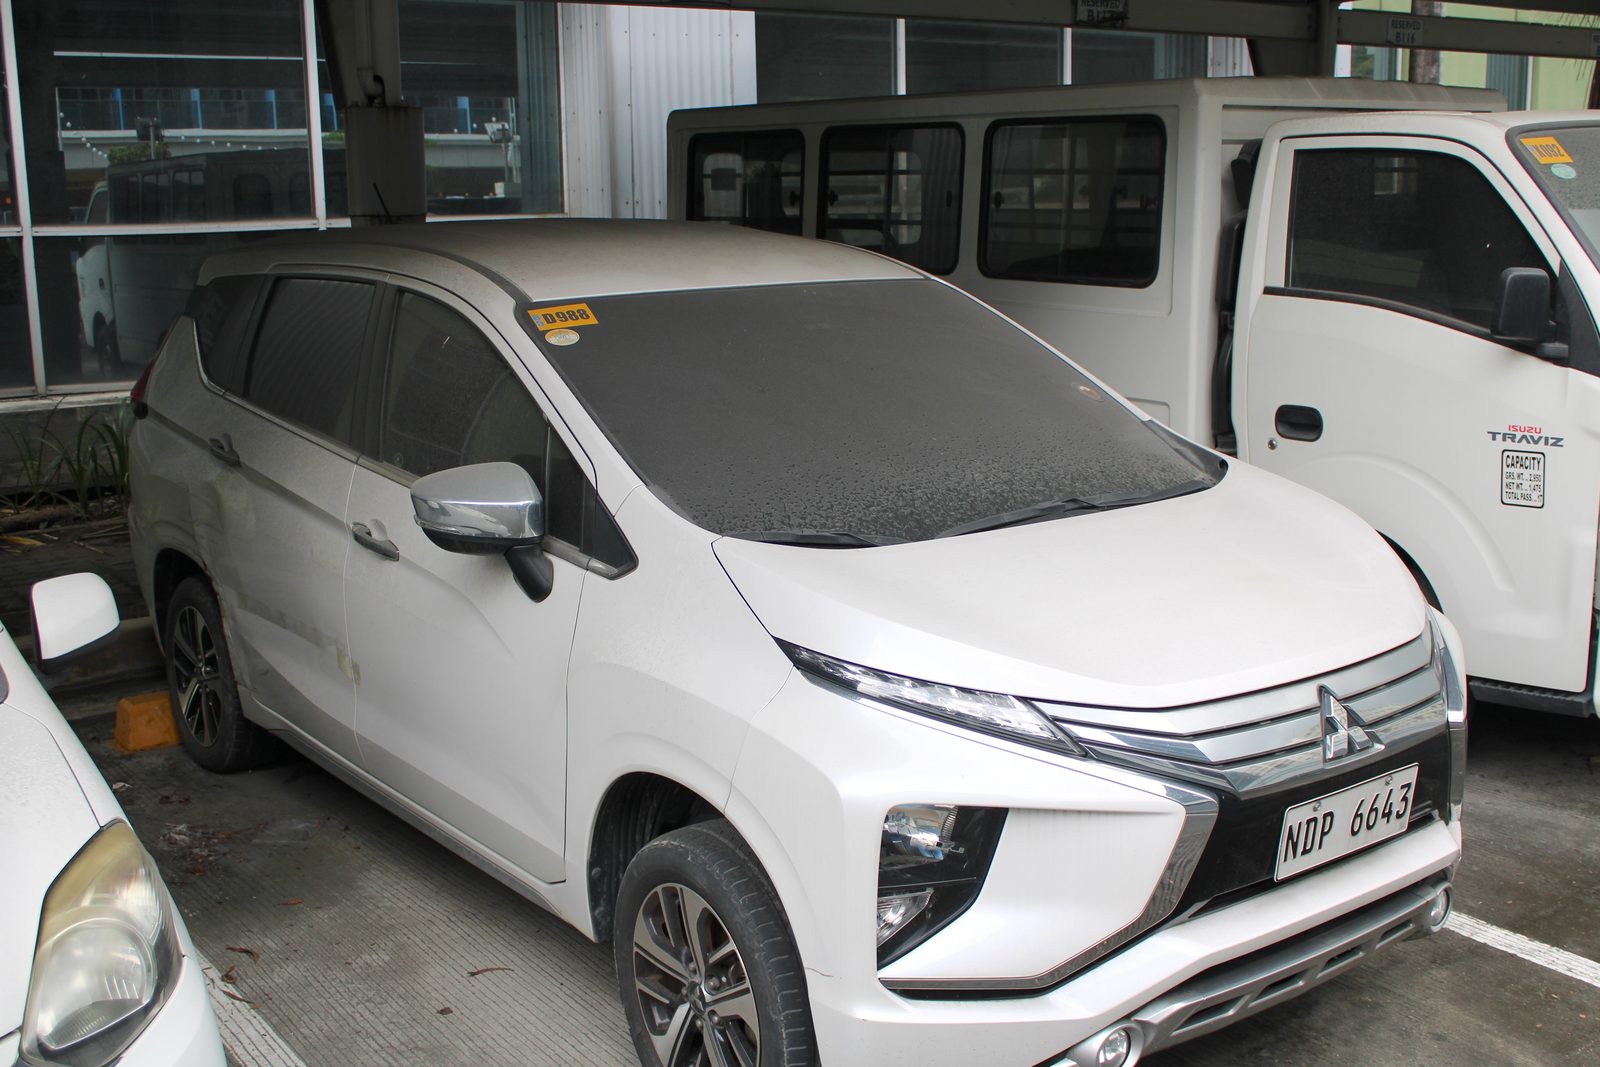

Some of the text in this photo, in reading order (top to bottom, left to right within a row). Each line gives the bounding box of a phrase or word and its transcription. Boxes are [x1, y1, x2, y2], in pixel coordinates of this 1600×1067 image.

[1392, 19, 1421, 30] RESERVED
[542, 309, 590, 324] D988
[1508, 425, 1542, 434] ISUZU
[1486, 431, 1564, 447] TRAVIZ
[1505, 454, 1542, 470] CAPACITY
[1505, 481, 1515, 490] NET
[1505, 491, 1519, 501] TOTAL
[1283, 782, 1412, 863] NDP 6643
